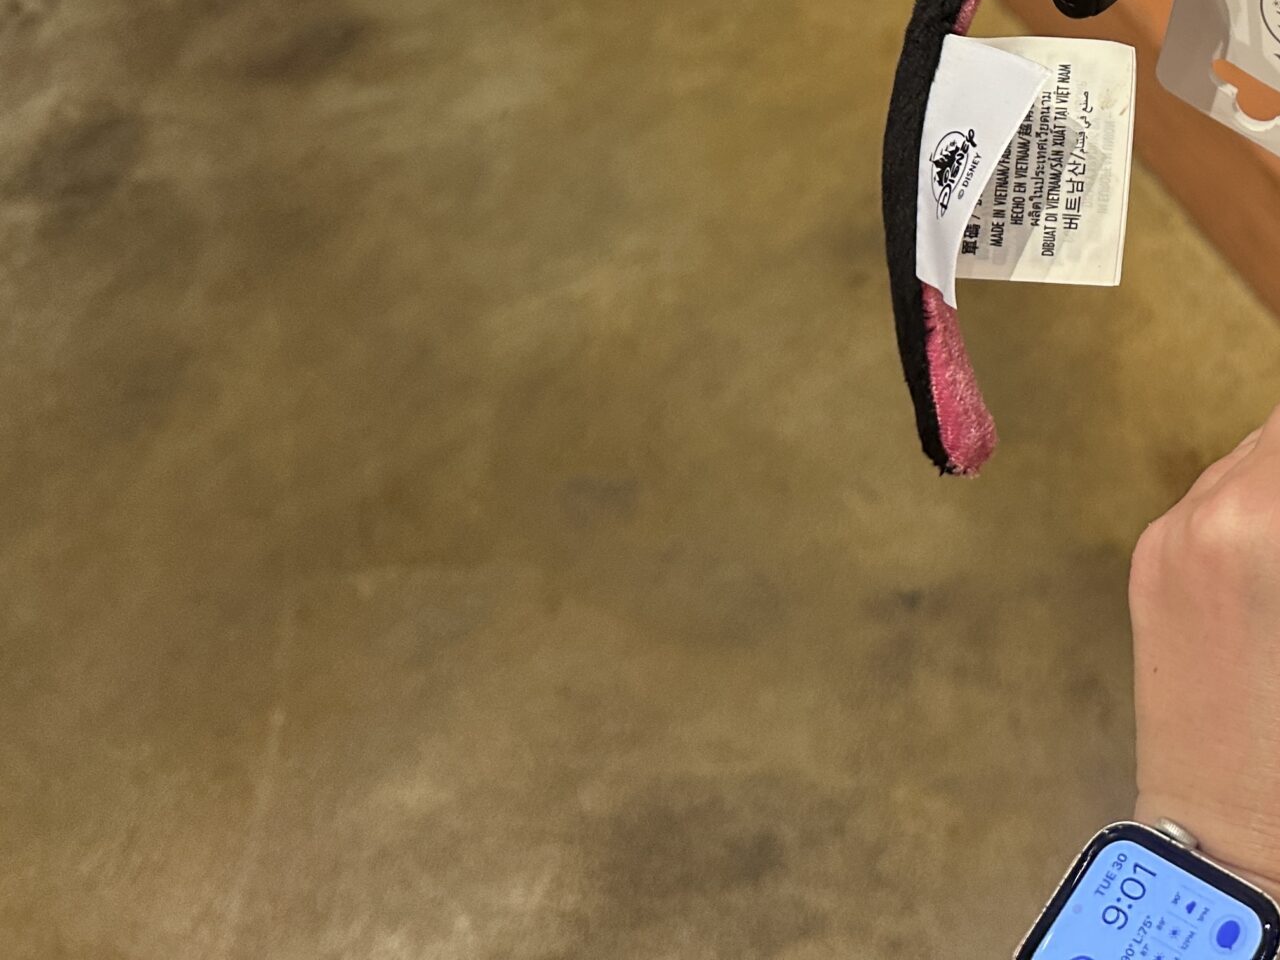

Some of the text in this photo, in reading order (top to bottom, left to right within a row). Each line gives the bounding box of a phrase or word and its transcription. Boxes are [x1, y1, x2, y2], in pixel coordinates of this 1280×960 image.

[1057, 64, 1071, 83] NAM
[962, 152, 982, 188] DISNEY
[1013, 181, 1027, 193] EN
[993, 208, 1006, 219] IN
[1010, 196, 1026, 225] HECHO
[1044, 212, 1058, 223] DI
[990, 221, 1005, 247] MADE
[1041, 226, 1057, 257] DIBUAT
[1094, 852, 1128, 898] TUE 30
[1101, 861, 1158, 930] 9:01
